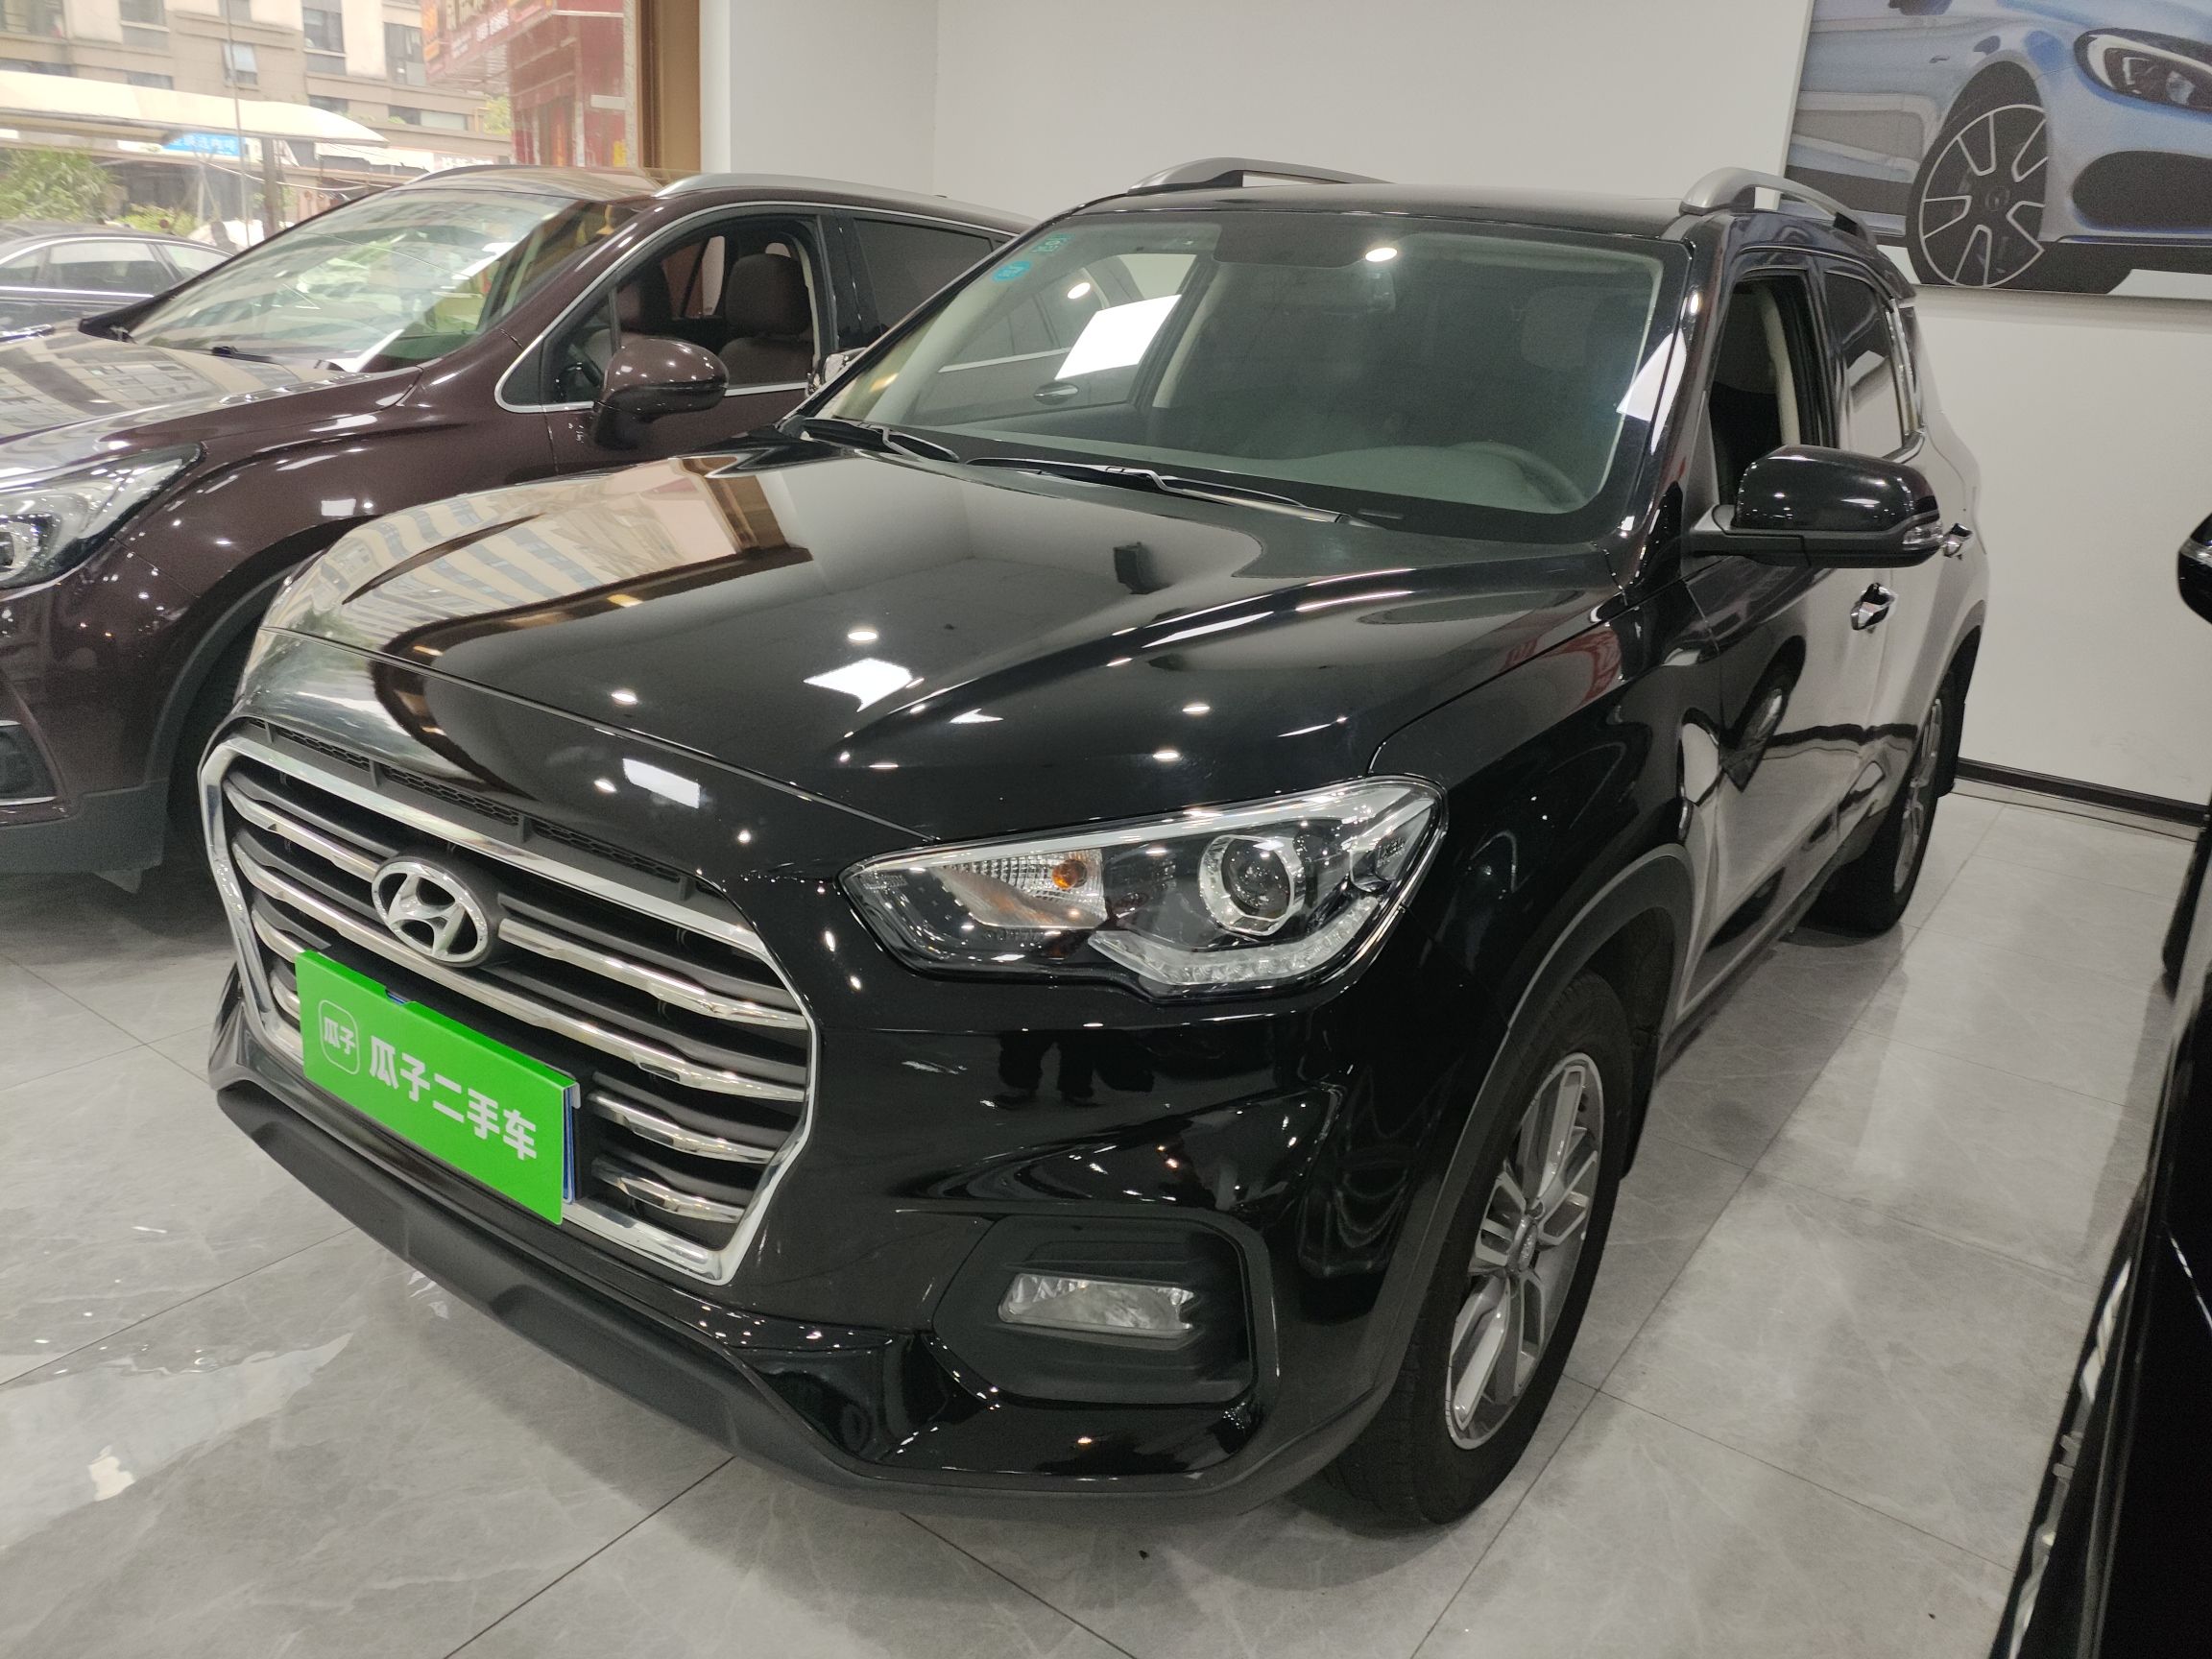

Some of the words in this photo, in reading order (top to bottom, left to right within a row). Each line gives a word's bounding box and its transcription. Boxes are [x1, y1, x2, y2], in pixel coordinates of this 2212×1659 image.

[324, 1017, 355, 1055] 瓜子
[369, 1035, 537, 1161] 瓜子二手车
